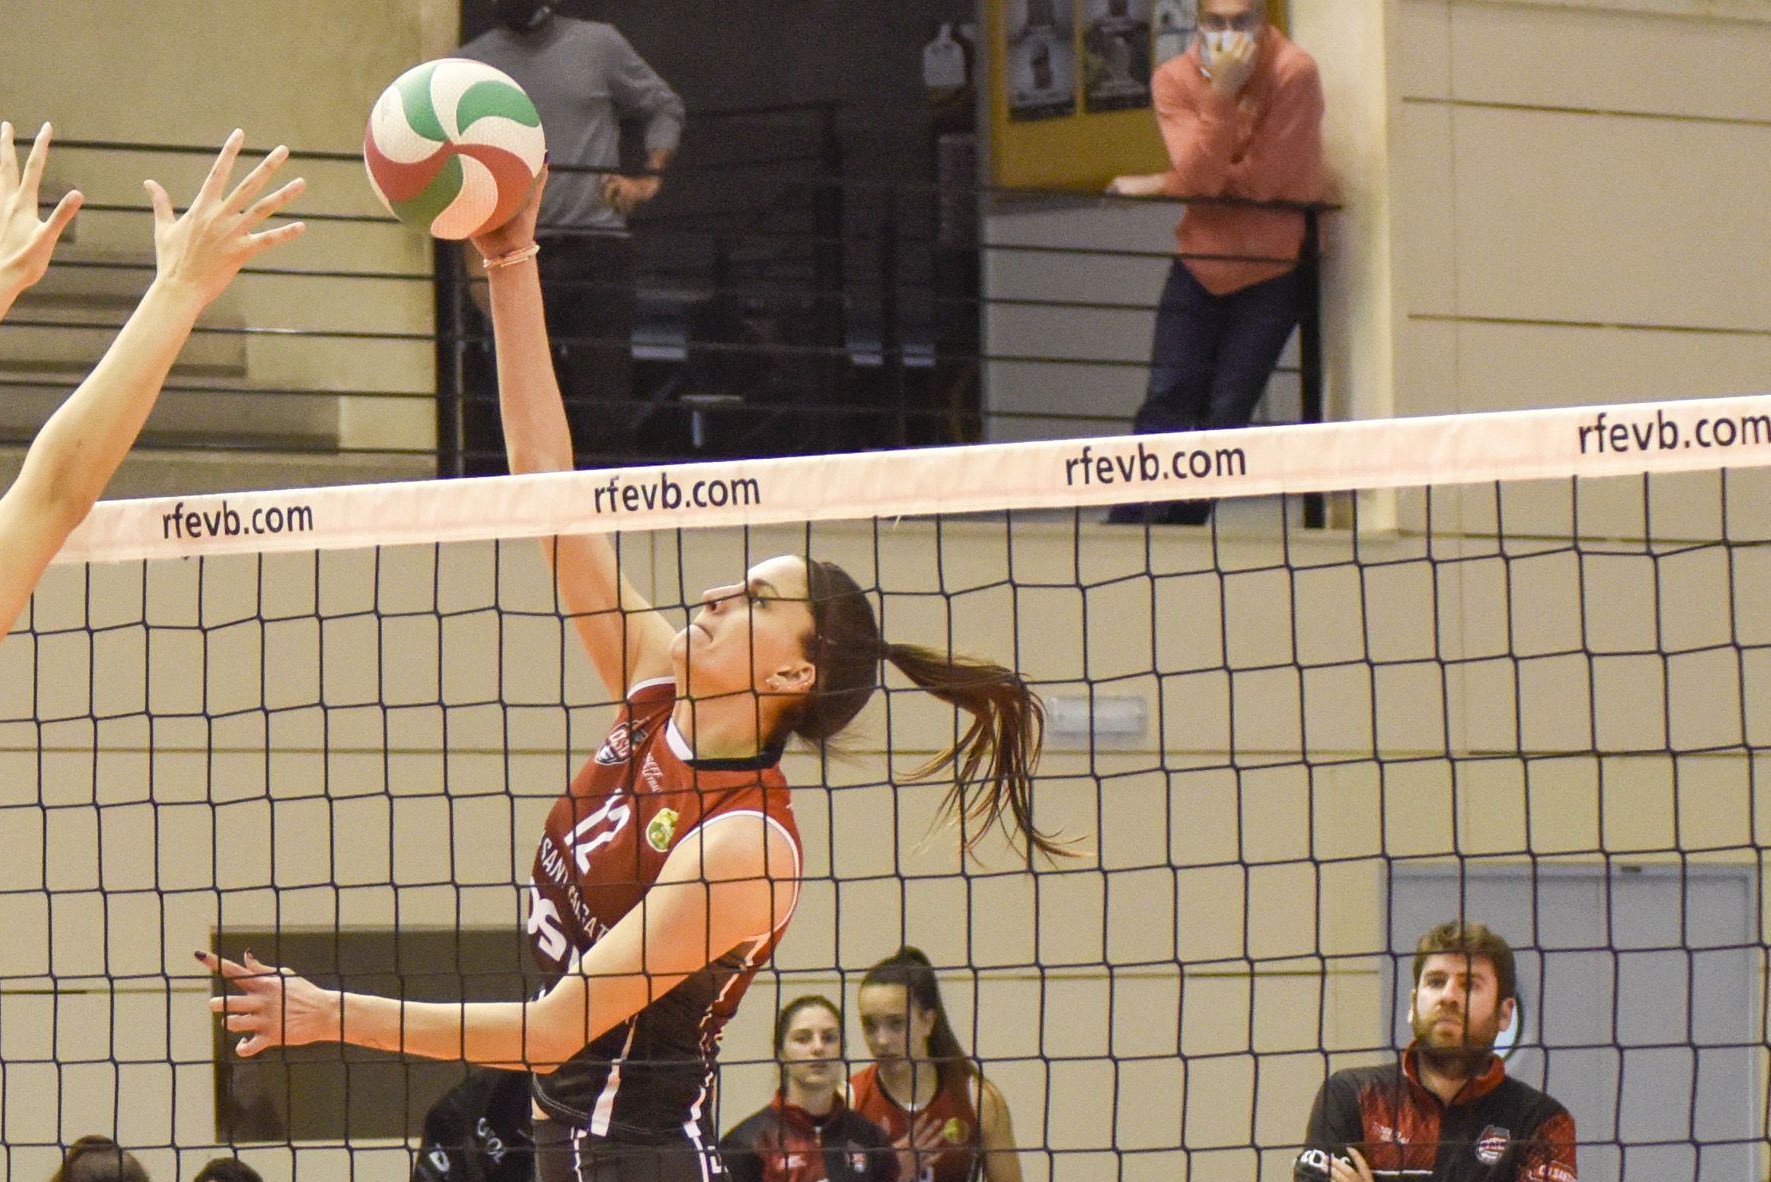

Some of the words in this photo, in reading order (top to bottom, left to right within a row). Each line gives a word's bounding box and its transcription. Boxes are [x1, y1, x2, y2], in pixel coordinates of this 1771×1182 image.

[1065, 442, 1246, 486] rfevb.com
[594, 472, 761, 514] rfevb.com
[162, 500, 314, 540] rfevb.com
